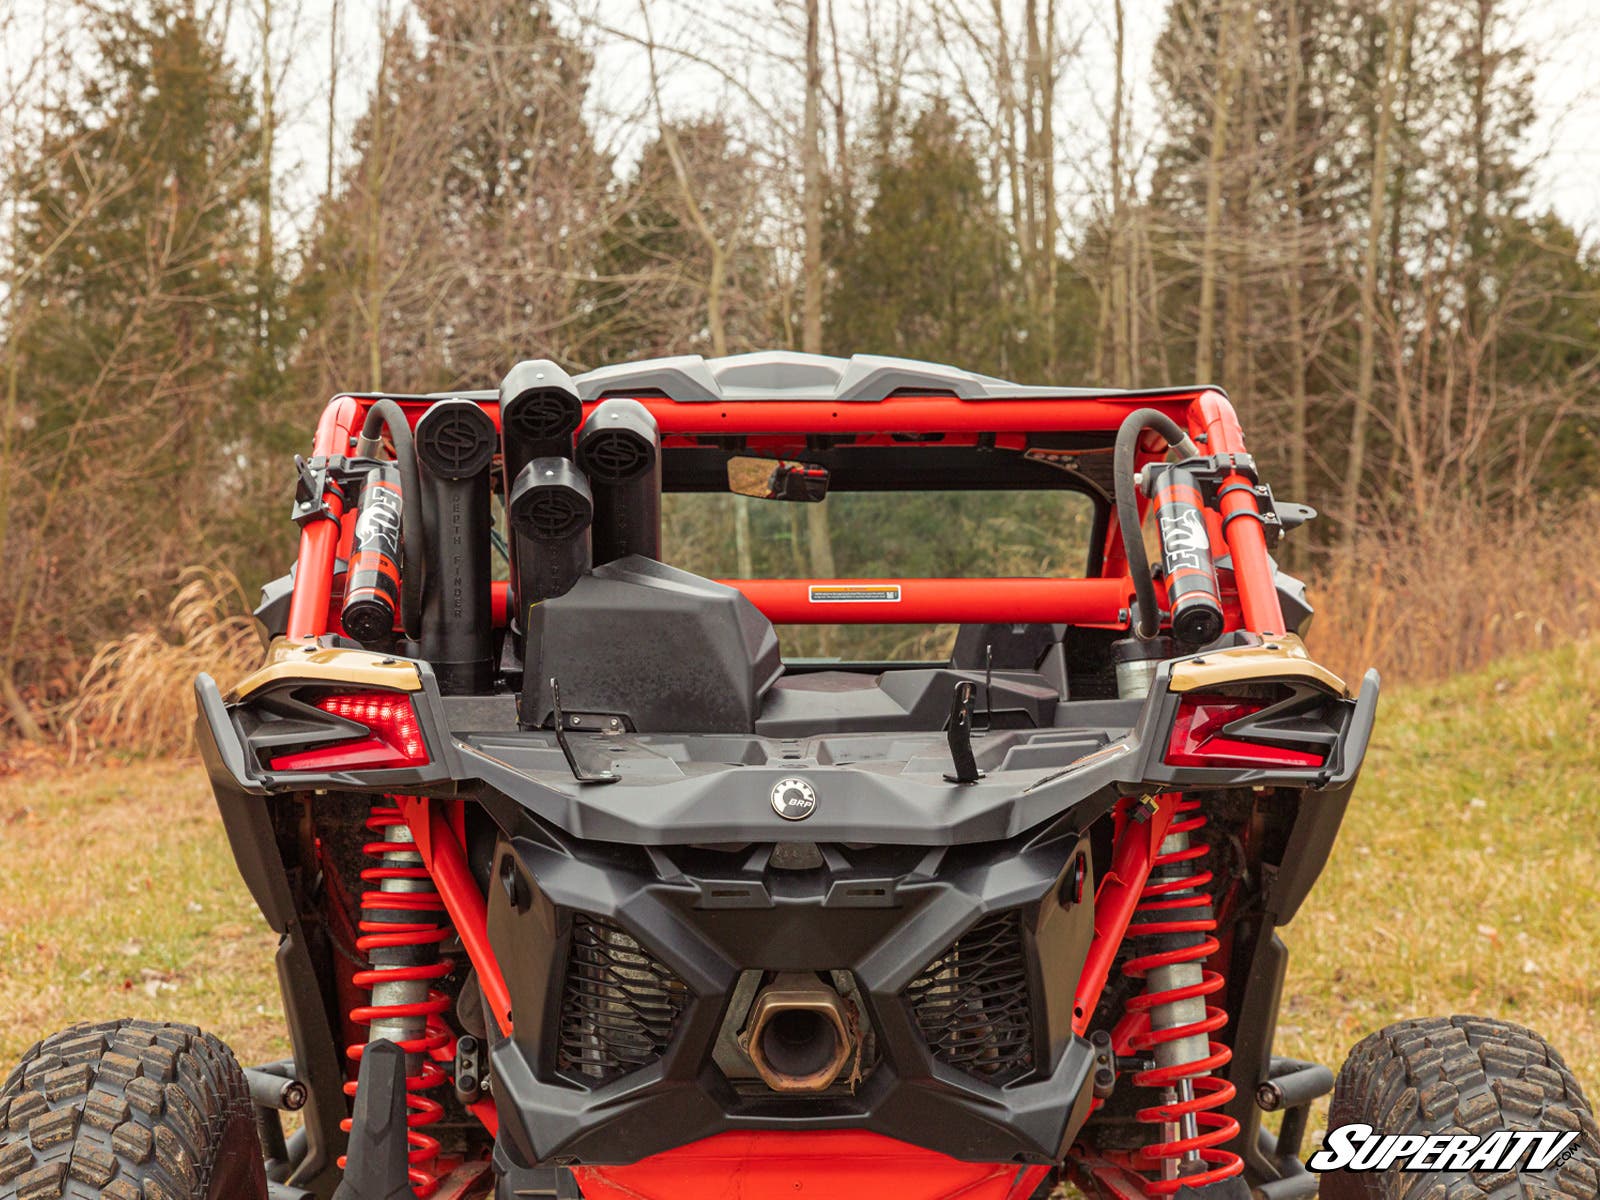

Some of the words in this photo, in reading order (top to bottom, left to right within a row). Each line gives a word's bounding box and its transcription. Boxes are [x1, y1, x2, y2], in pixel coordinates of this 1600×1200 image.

[357, 486, 402, 554] FOX
[452, 495, 461, 545] DEPTH
[1160, 510, 1207, 574] FOX
[453, 555, 462, 618] FINDER
[788, 798, 813, 808] BRP
